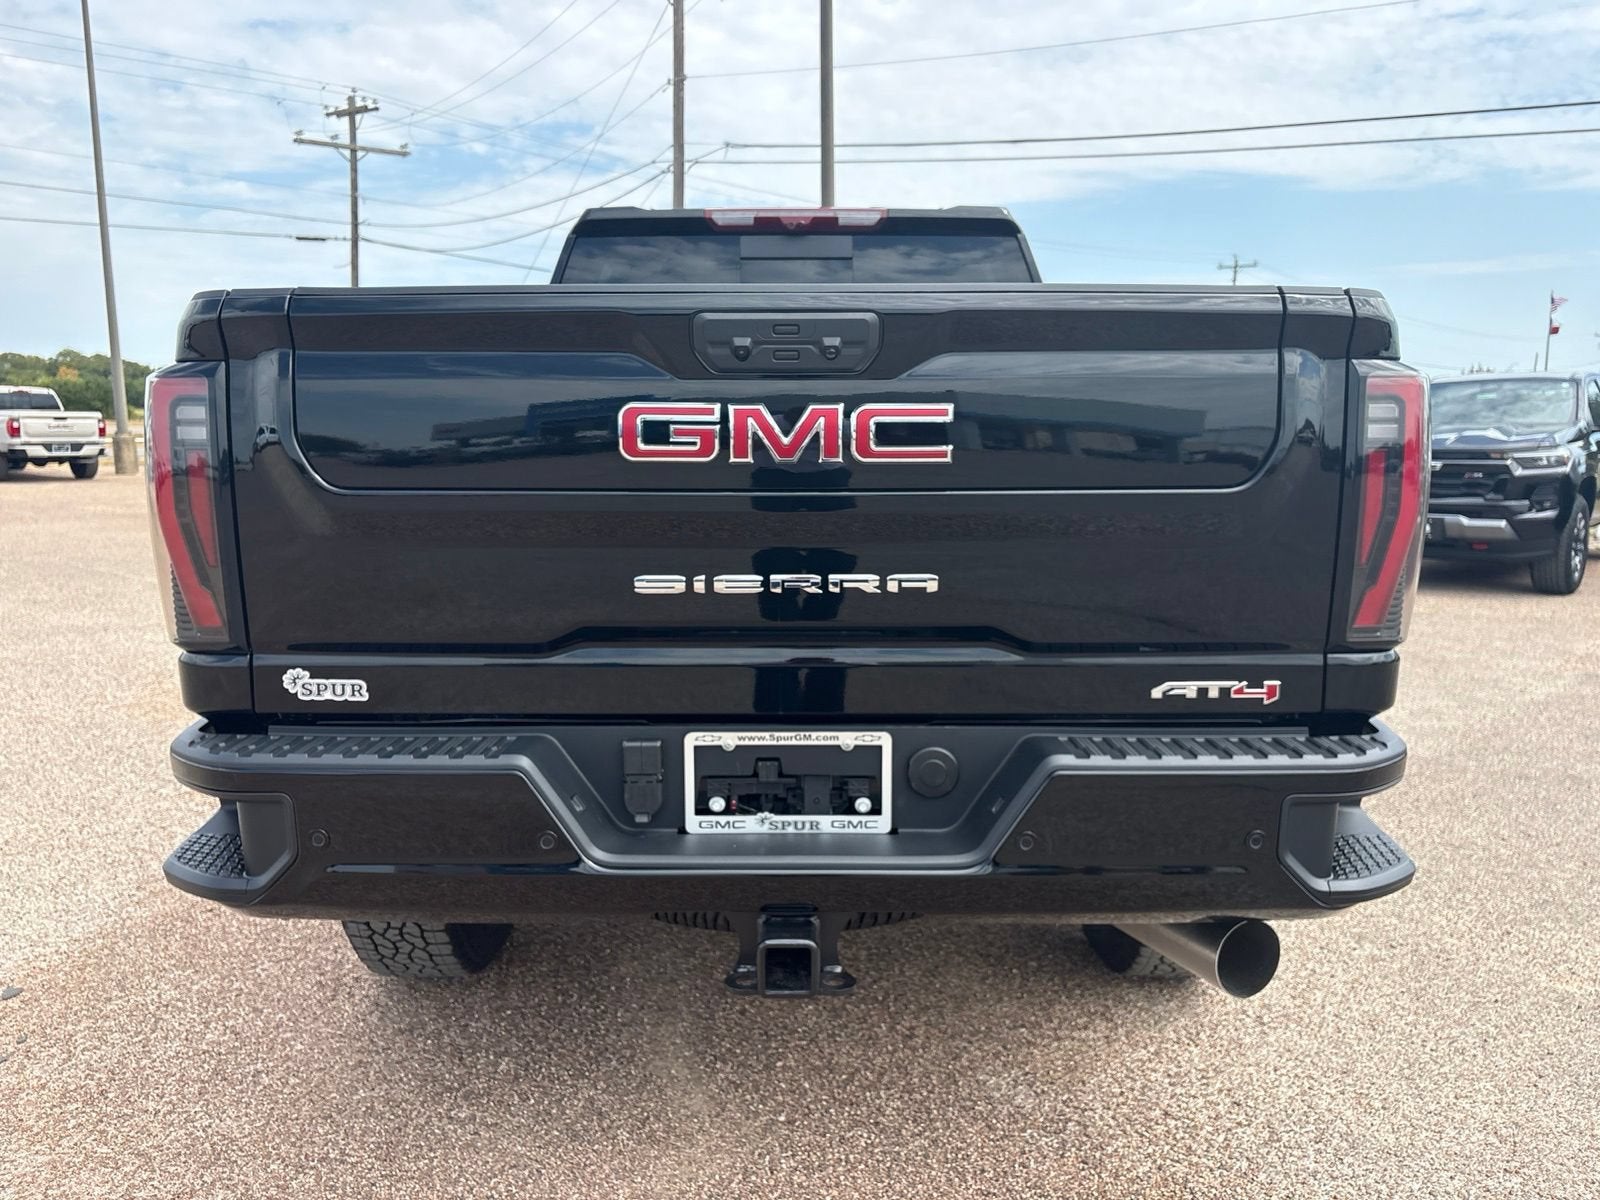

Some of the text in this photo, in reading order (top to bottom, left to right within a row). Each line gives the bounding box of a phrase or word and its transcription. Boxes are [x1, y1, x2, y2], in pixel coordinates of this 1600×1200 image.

[618, 402, 955, 463] GMC
[633, 573, 939, 594] SIERRA
[301, 682, 365, 697] SPUR
[1151, 680, 1282, 705] AT4
[737, 733, 840, 743] www.SpurGM.com
[699, 820, 879, 831] GMC SPUR GMC
